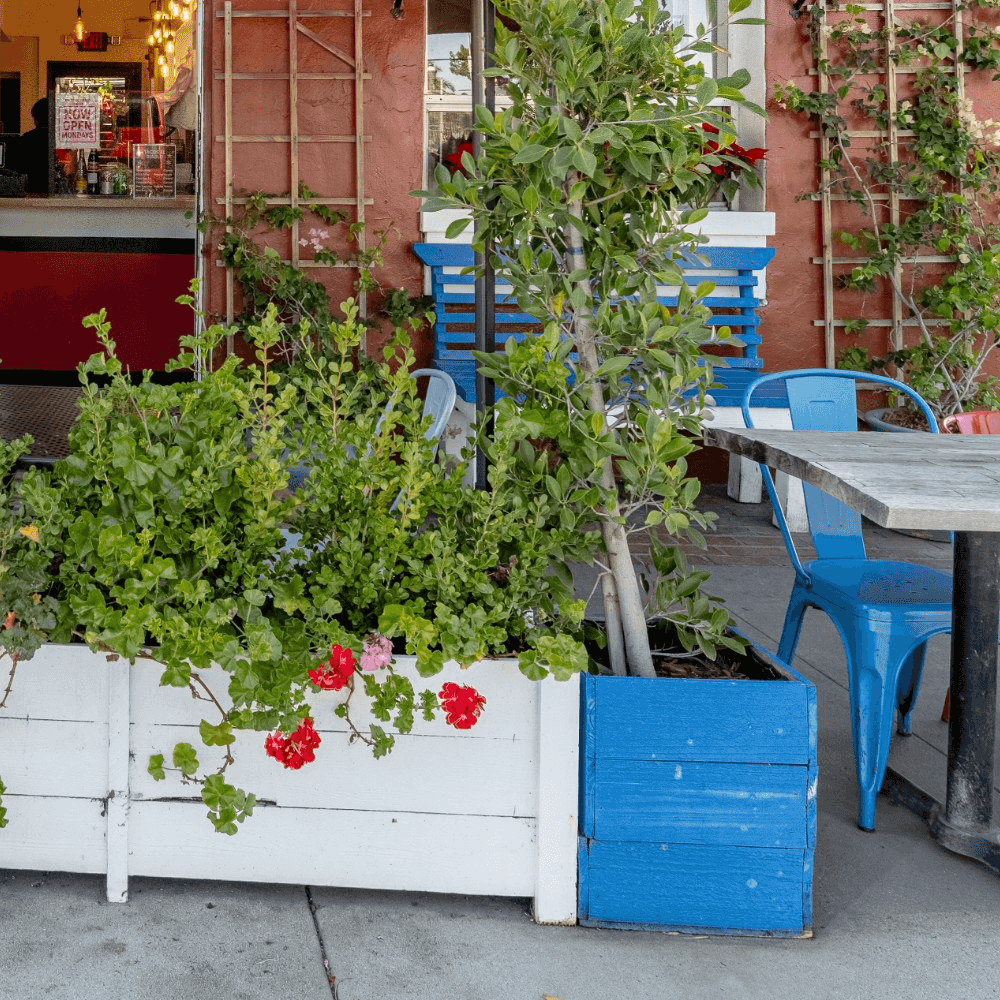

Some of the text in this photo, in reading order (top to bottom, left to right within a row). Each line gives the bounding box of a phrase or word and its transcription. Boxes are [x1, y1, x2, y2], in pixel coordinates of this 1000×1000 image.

[63, 109, 91, 120] NOW
[63, 120, 92, 131] OPEN
[61, 131, 94, 139] MONDAYS
